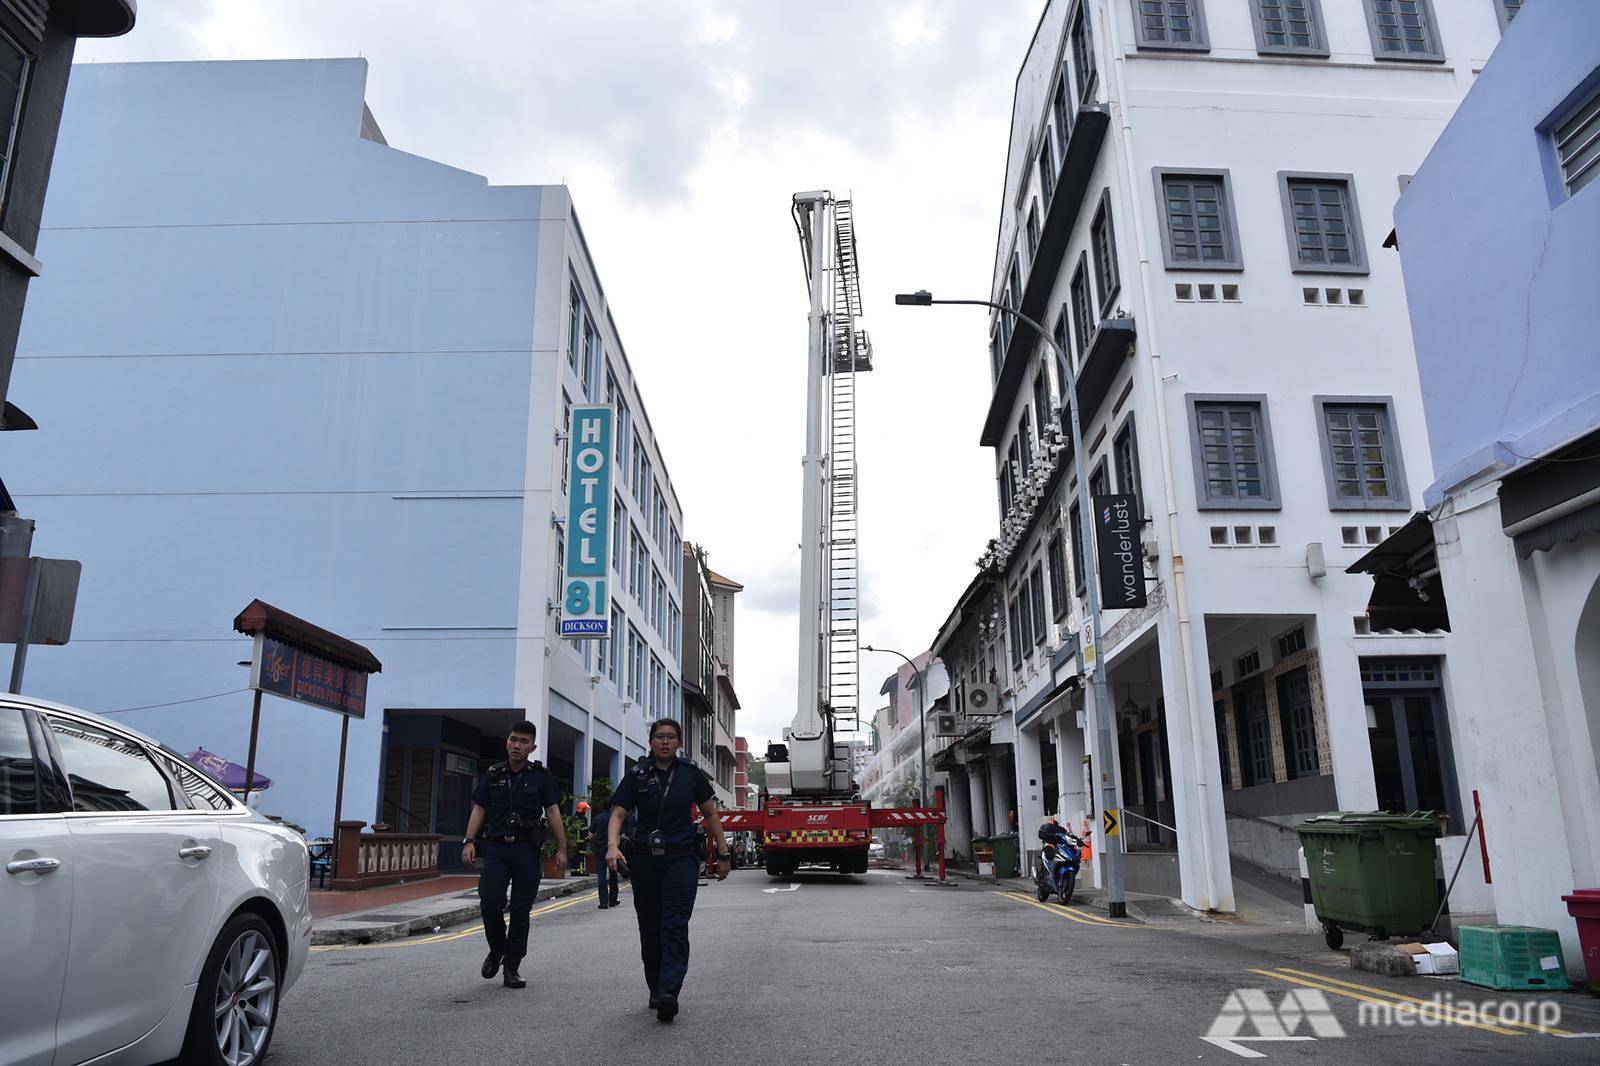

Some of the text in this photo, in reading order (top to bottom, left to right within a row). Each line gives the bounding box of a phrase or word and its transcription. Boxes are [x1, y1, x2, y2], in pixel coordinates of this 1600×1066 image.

[566, 418, 605, 615] HOTEL 81
[1111, 499, 1137, 602] wanderlust
[564, 620, 605, 632] DICKSON
[265, 652, 290, 682] Tiger
[297, 680, 325, 700] DICKSON
[326, 689, 342, 705] FOOD
